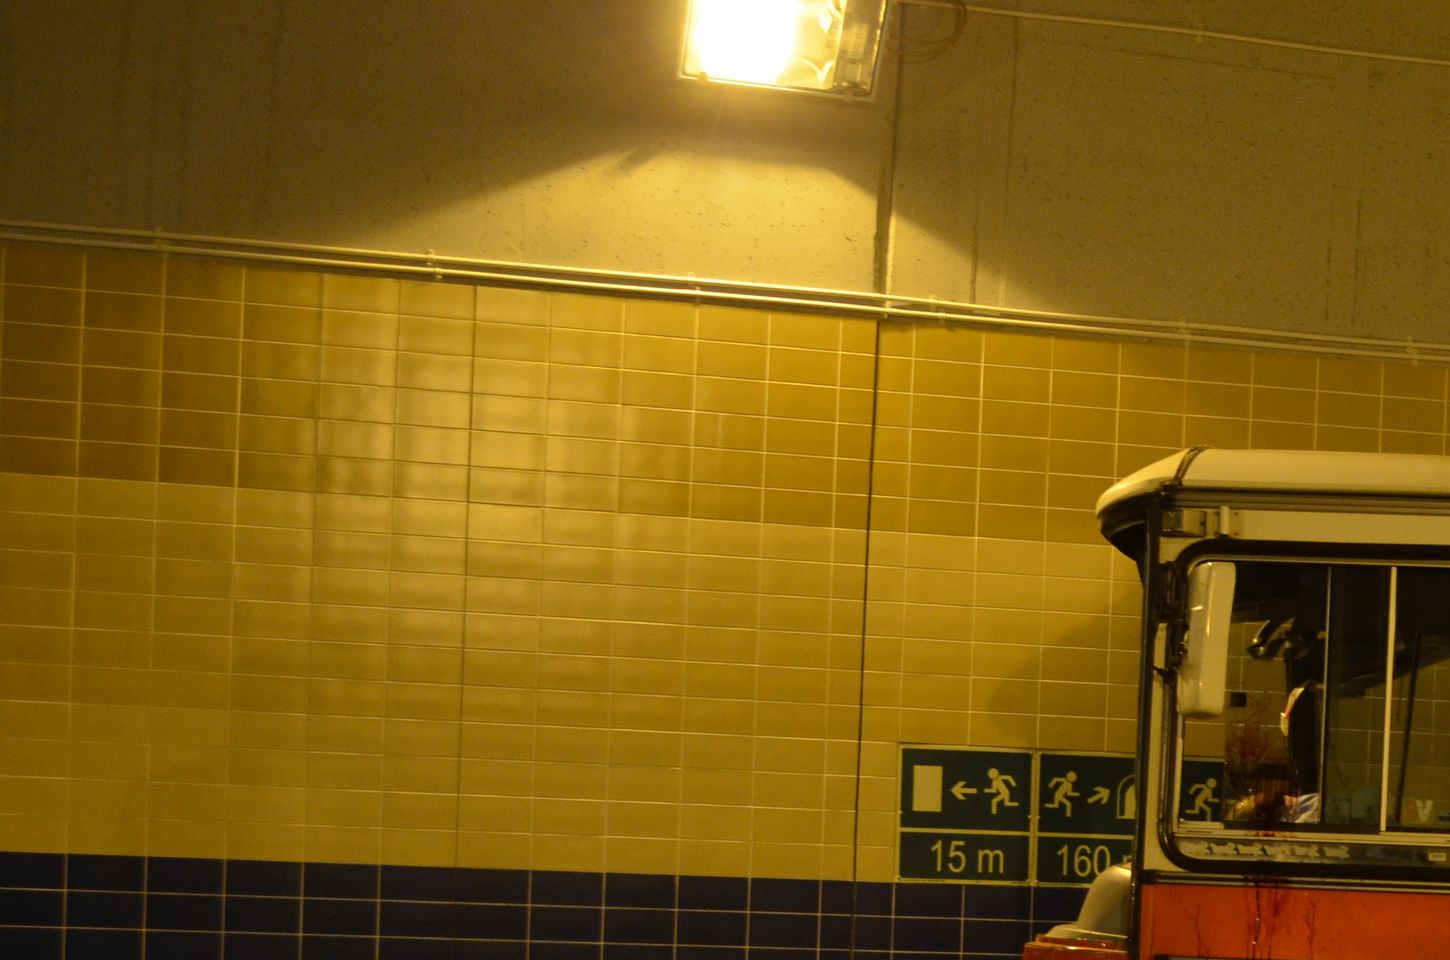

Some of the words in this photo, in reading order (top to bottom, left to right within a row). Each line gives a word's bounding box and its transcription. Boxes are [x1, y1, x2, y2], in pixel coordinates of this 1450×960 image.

[930, 839, 967, 873] 15
[977, 848, 1005, 873] m
[1056, 843, 1111, 877] 160
